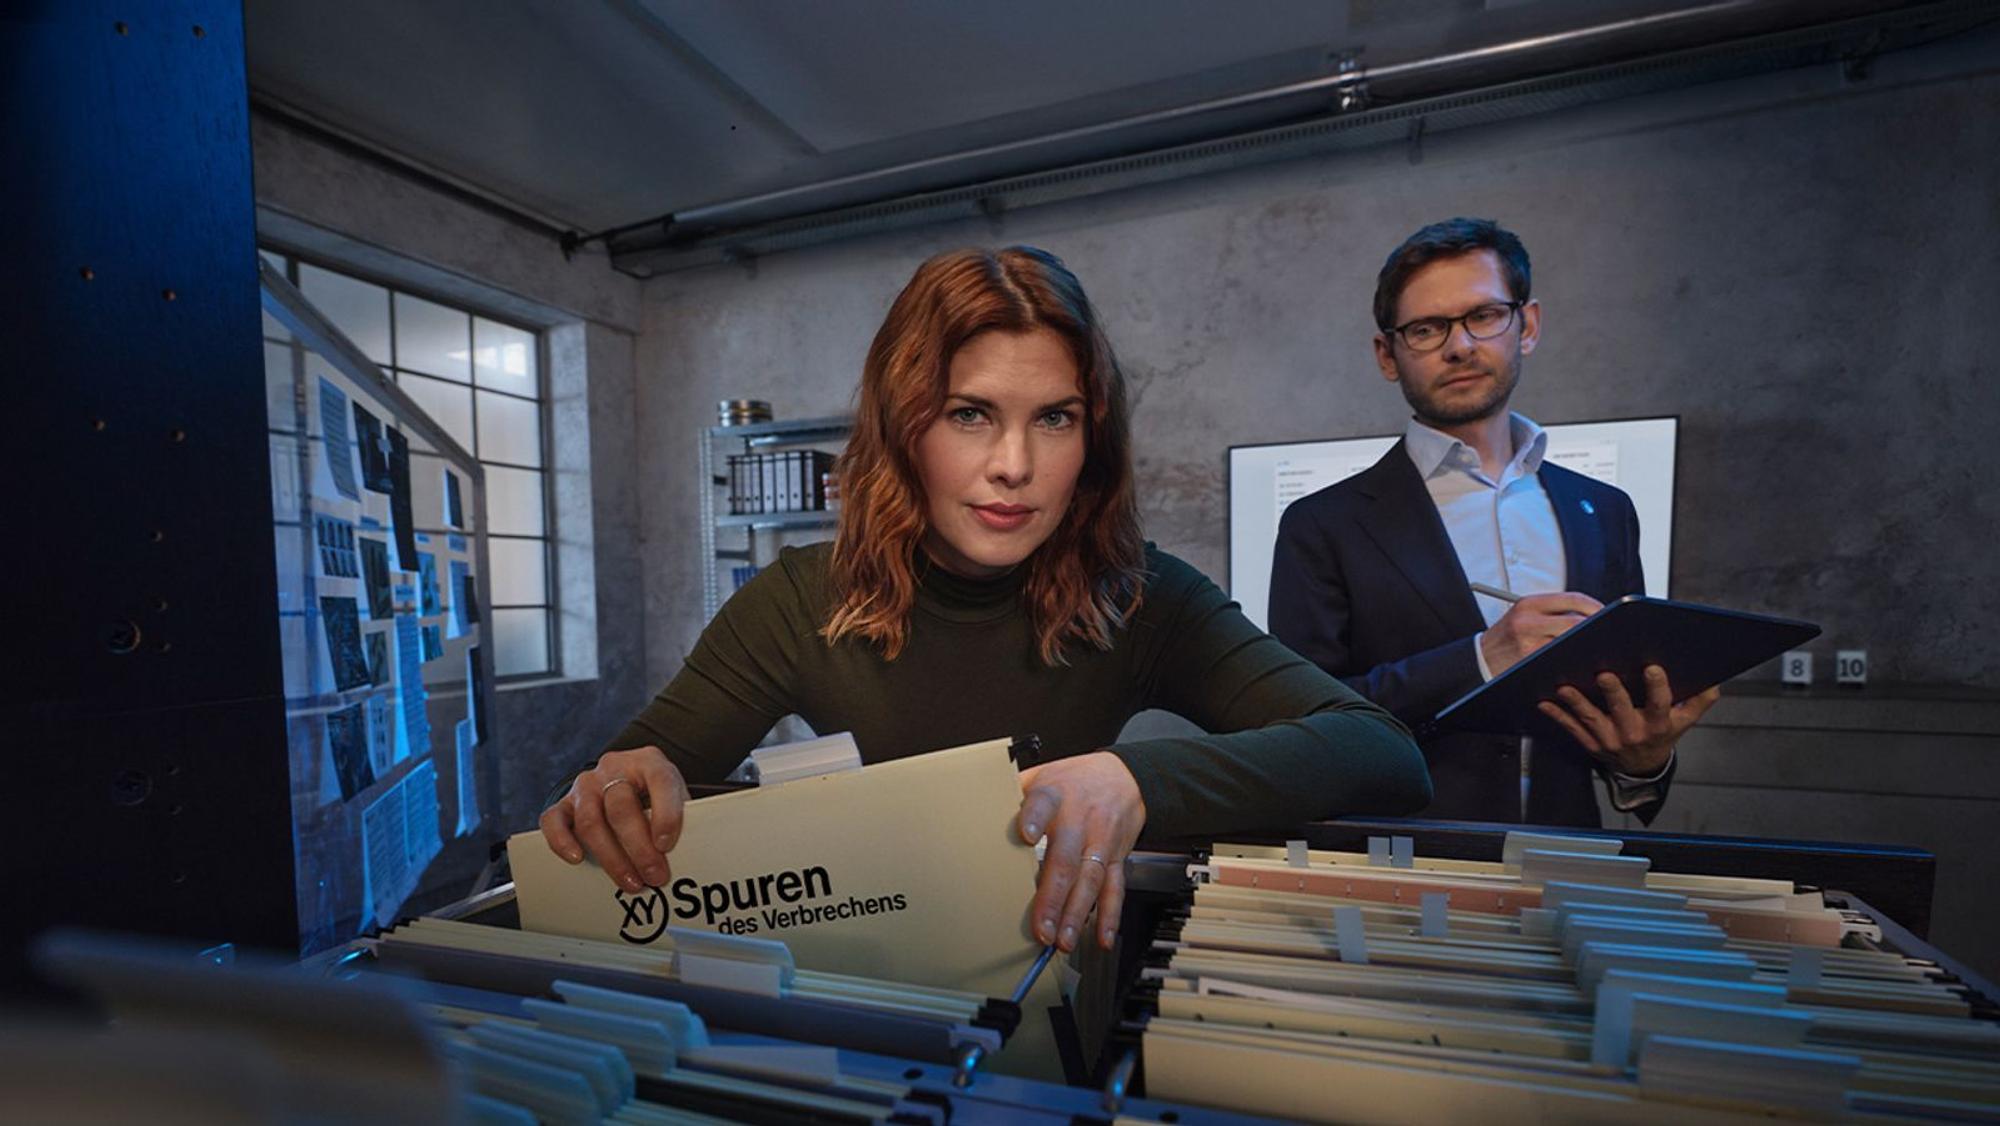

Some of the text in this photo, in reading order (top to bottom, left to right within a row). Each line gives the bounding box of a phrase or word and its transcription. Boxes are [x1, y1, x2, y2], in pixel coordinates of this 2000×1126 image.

[1791, 658, 1804, 677] 8
[1839, 658, 1865, 677] 10
[618, 893, 657, 929] XY
[672, 865, 832, 925] Spuren
[718, 893, 907, 935] des Verbrechens
